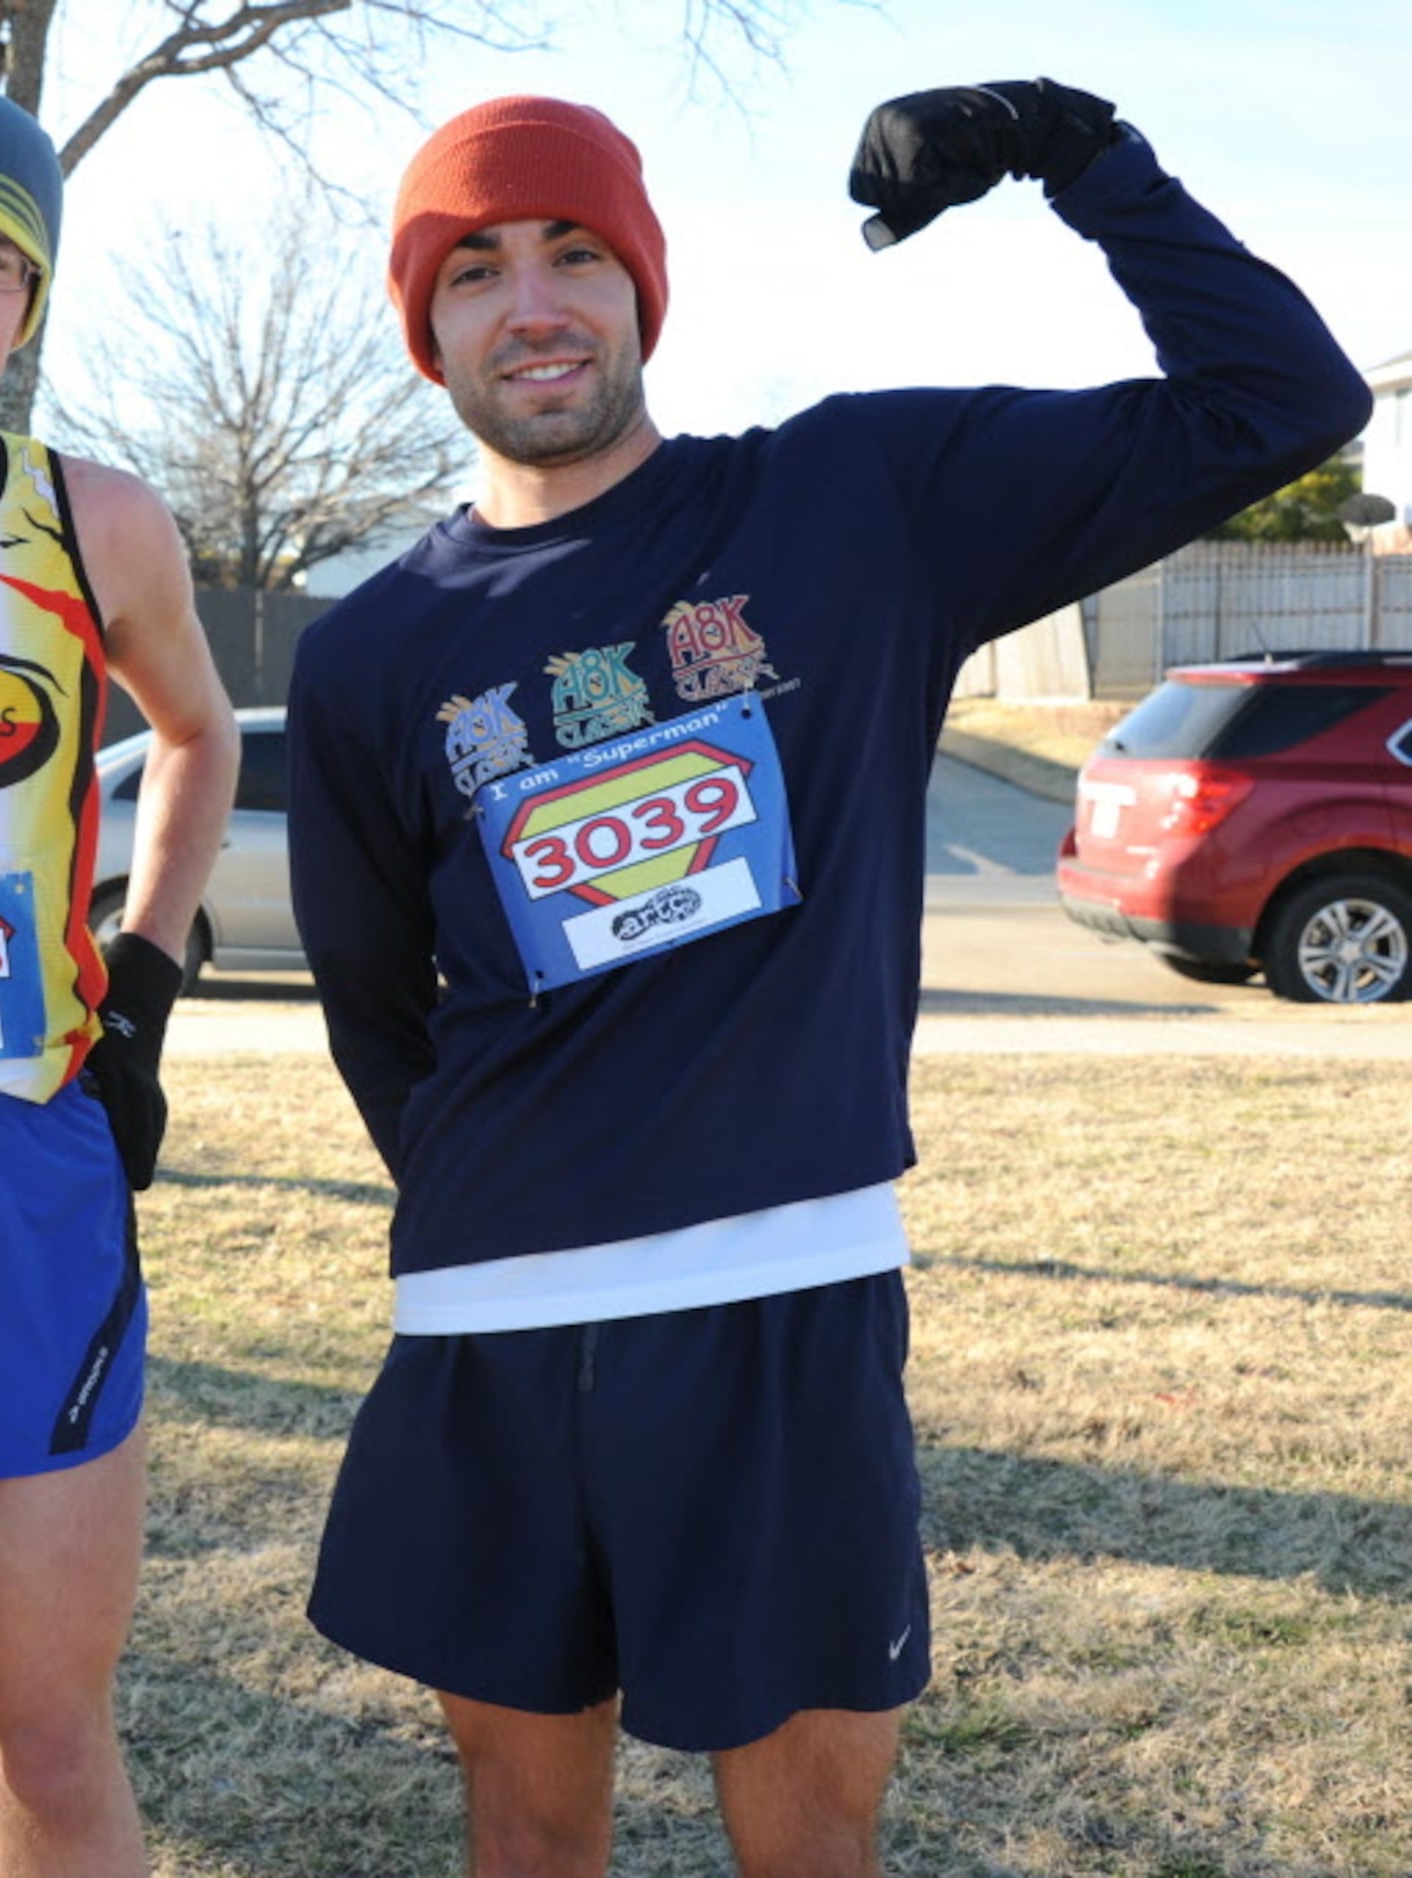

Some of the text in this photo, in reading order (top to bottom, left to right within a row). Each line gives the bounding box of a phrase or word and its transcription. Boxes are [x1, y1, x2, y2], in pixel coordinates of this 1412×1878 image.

[491, 783, 507, 801] I
[519, 768, 559, 791] am
[523, 777, 740, 889] 3039
